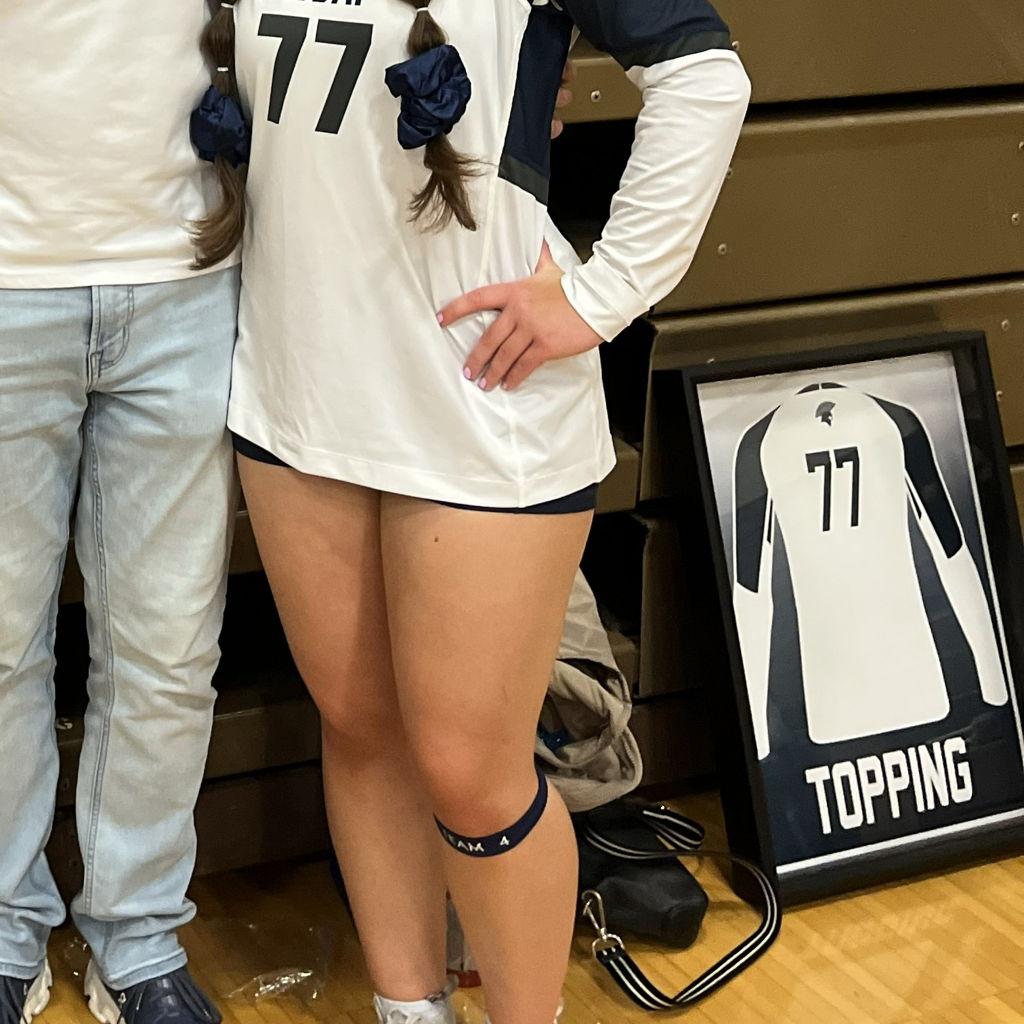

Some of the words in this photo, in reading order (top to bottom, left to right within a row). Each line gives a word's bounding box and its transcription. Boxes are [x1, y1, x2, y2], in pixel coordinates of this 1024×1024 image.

[257, 13, 374, 135] 77
[805, 446, 860, 532] 77
[805, 736, 974, 835] TOPPING
[499, 835, 511, 847] 4
